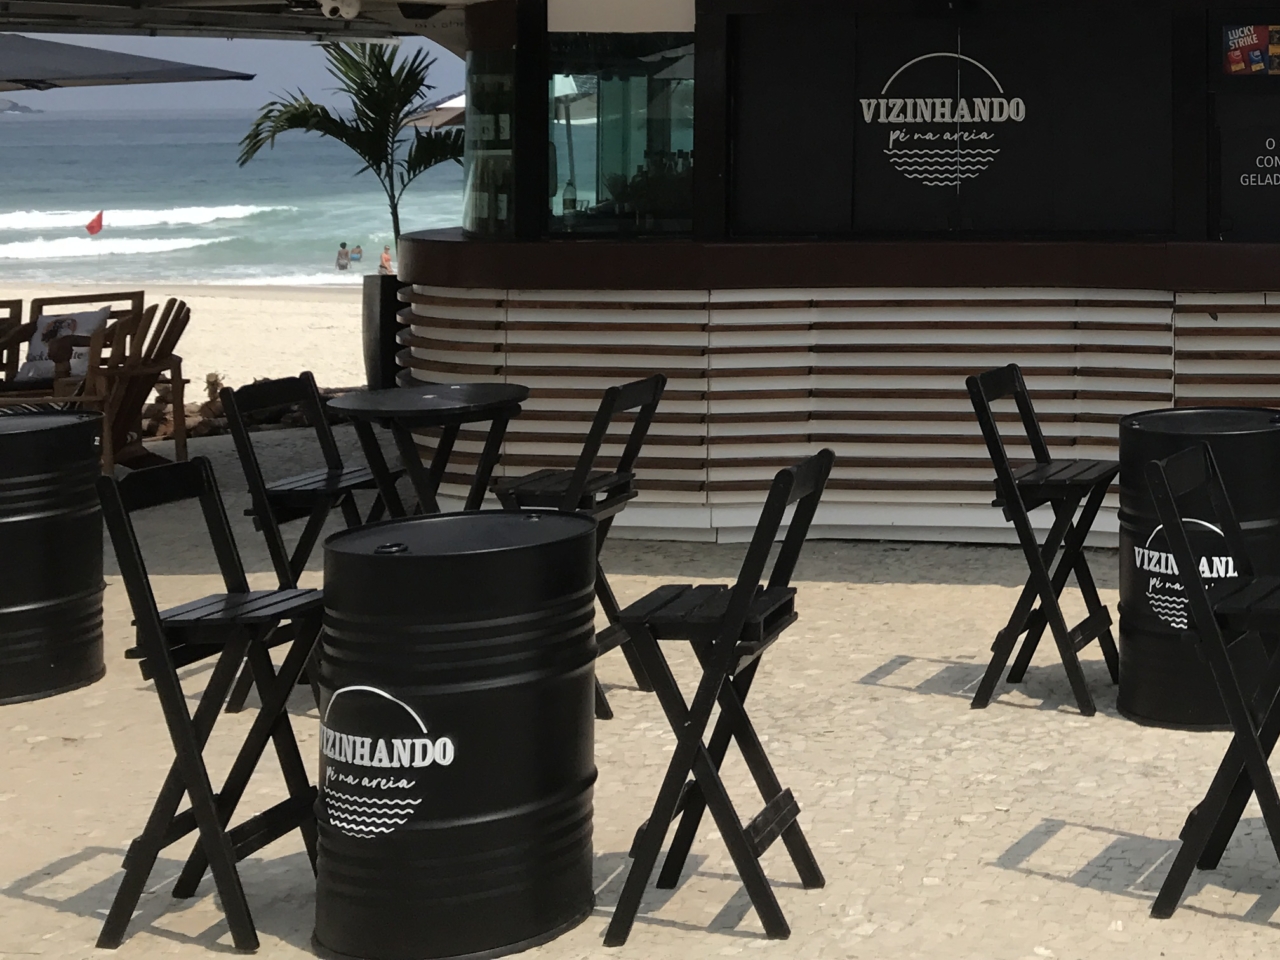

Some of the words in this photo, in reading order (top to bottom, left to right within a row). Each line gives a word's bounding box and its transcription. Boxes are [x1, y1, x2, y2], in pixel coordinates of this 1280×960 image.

[1228, 25, 1255, 40] LUCKY
[1228, 34, 1259, 50] STRIKE
[859, 97, 1026, 123] VIZINHANDO
[889, 128, 910, 149] pé
[914, 132, 940, 141] na
[943, 129, 995, 141] areia
[1265, 138, 1276, 150] O
[361, 775, 416, 790] areia
